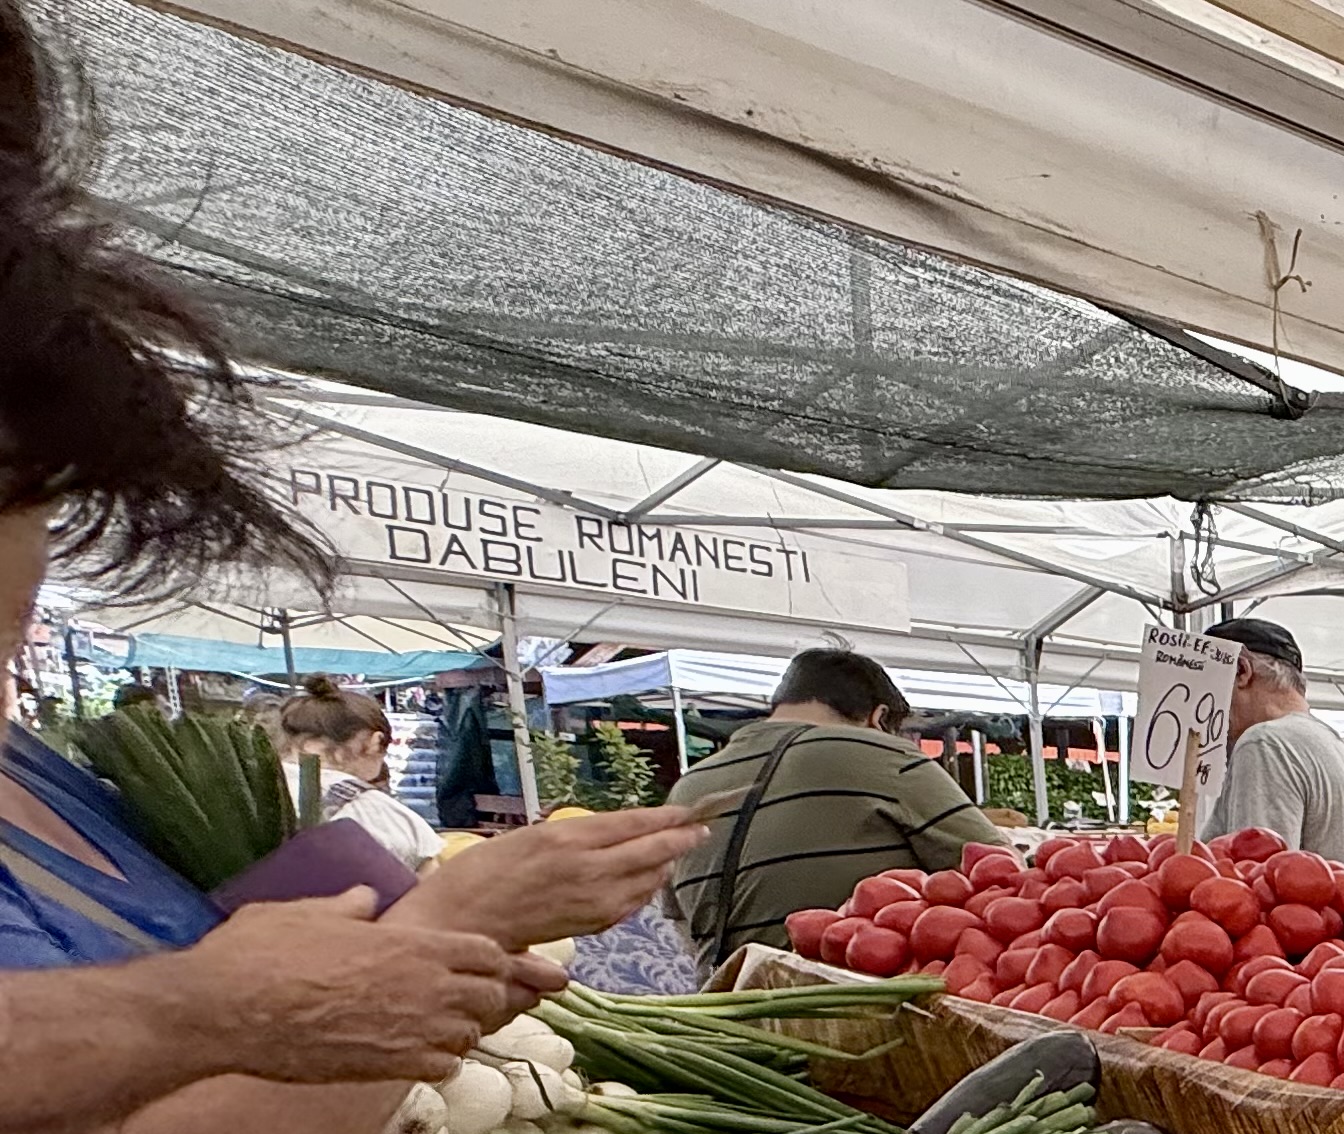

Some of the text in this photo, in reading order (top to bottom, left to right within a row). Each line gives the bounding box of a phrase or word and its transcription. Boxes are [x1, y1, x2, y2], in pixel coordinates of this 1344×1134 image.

[291, 469, 811, 583] PRODUSE ROMANESTI
[386, 524, 699, 602] DABULENI
[1146, 683, 1224, 770] 6 90
